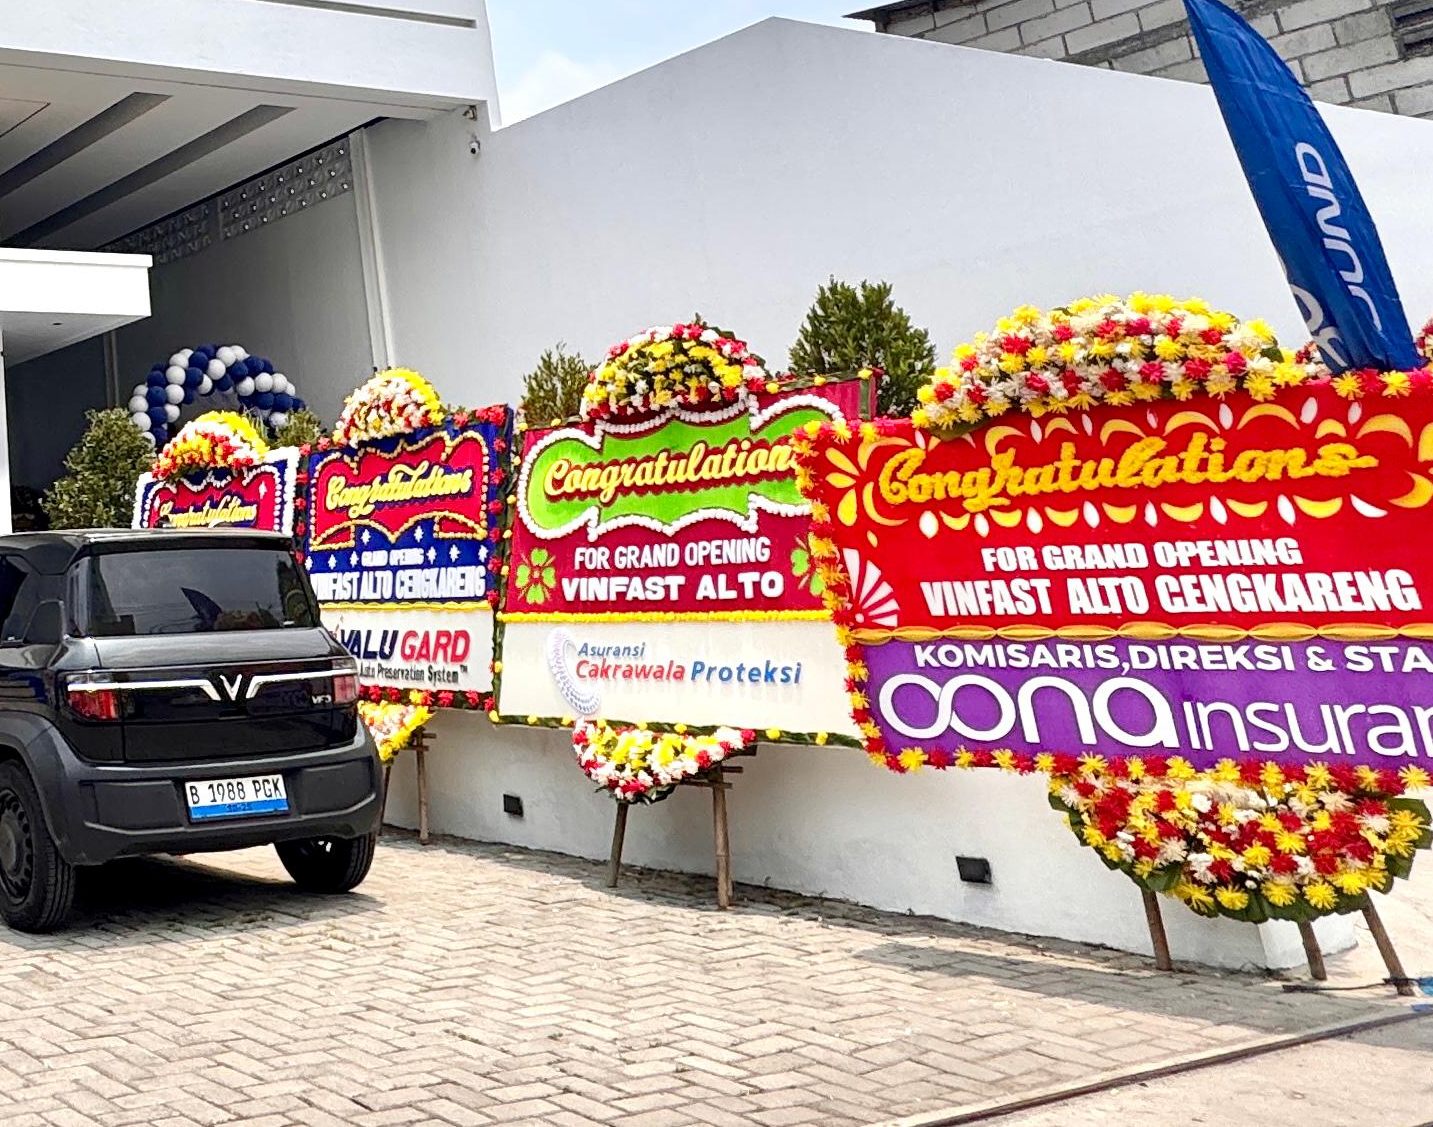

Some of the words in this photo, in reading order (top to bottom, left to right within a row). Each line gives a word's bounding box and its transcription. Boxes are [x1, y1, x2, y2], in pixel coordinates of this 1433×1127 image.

[879, 432, 1379, 513] Congratulations
[574, 547, 611, 571] FOR
[615, 543, 680, 569] GRAND
[685, 537, 771, 566] OPENING
[981, 547, 1038, 572] FOR
[1042, 543, 1149, 570] GRAND
[1153, 537, 1304, 568] OPENING
[359, 569, 394, 600] ALTO
[395, 565, 487, 600] CENGKARENG
[561, 576, 686, 602] VINFAST
[696, 571, 784, 601] ALTO
[920, 578, 1053, 616] VINFAST
[1067, 575, 1150, 614] ALTO
[1154, 569, 1423, 613] CENGKARENG
[578, 641, 646, 657] Asuransi
[1305, 645, 1337, 672] &
[377, 663, 425, 681] Preservation
[576, 658, 686, 682] Cakrawala
[690, 659, 802, 684] Proteksi
[189, 785, 200, 805] B
[207, 781, 246, 803] 1988
[251, 777, 283, 799] PGK
